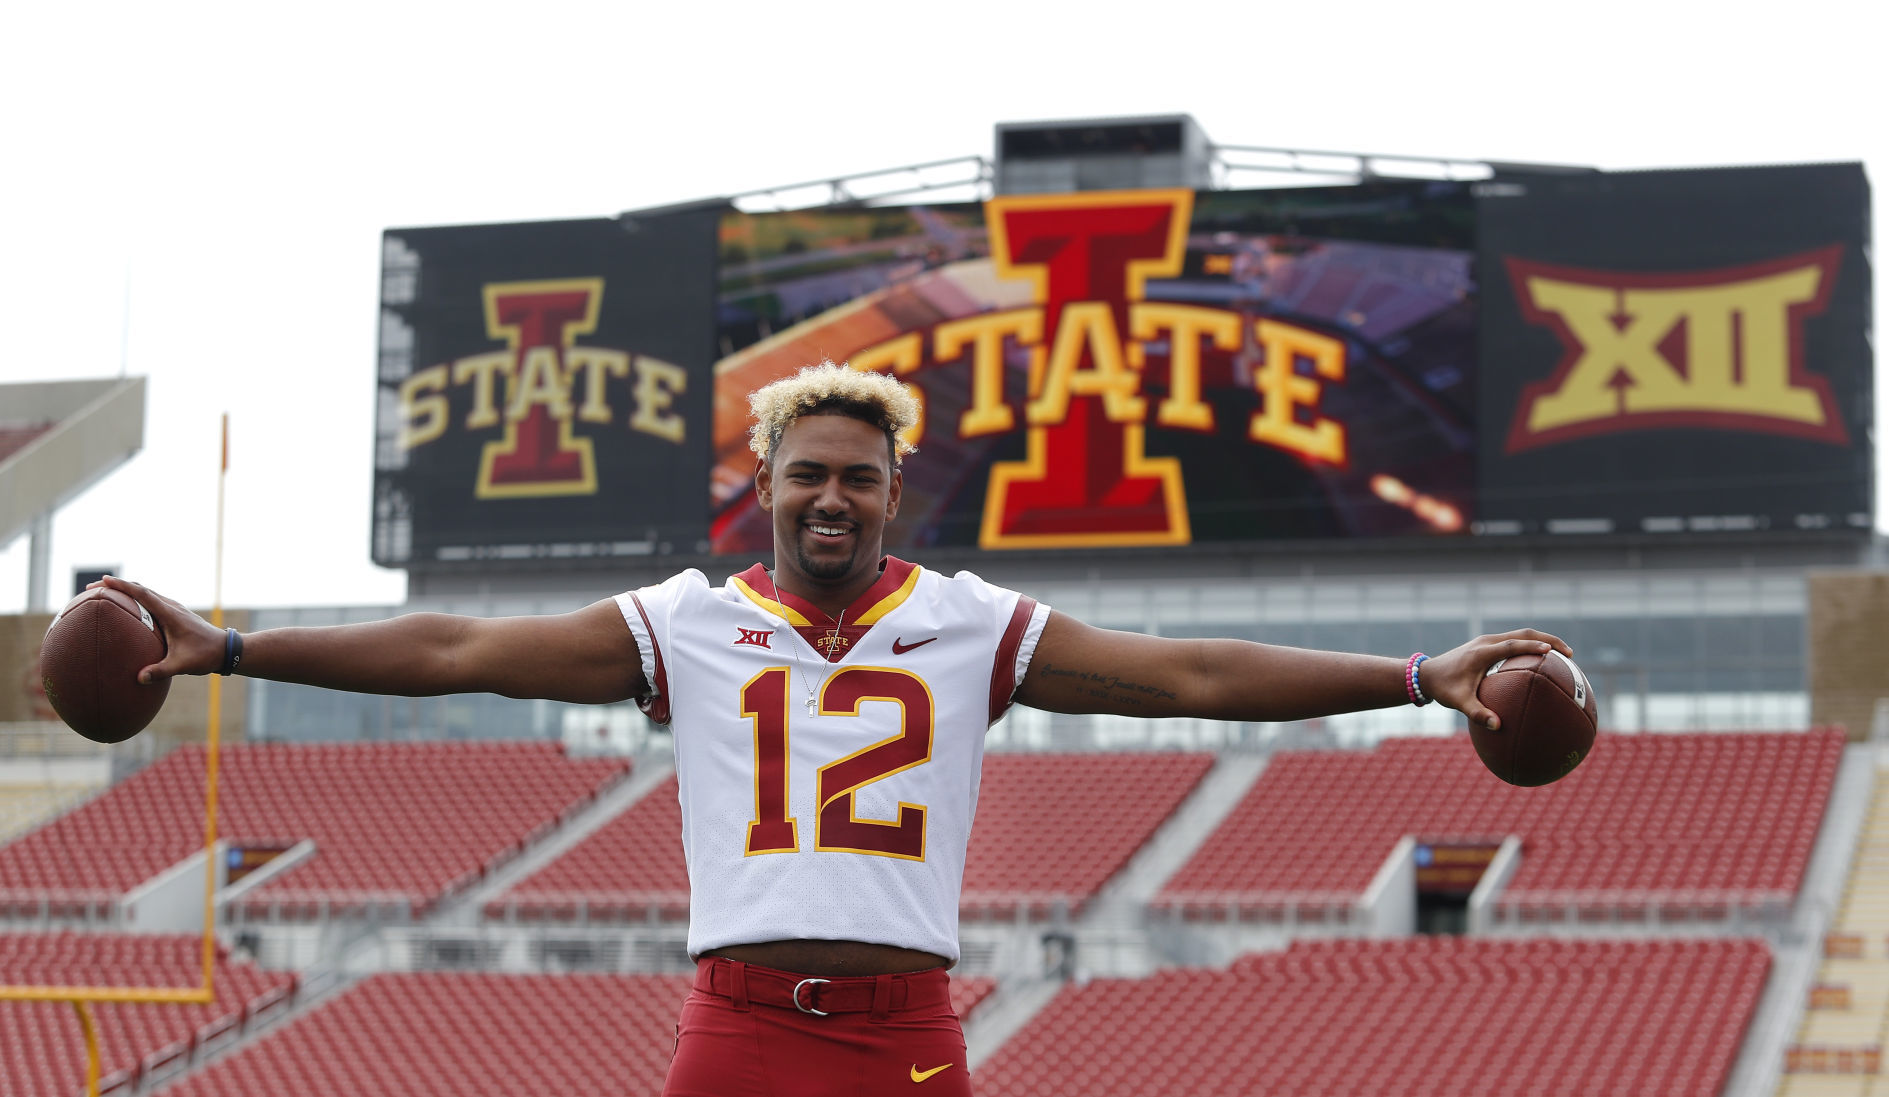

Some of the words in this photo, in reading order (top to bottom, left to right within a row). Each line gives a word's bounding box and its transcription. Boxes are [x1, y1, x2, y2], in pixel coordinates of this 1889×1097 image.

[395, 346, 687, 444] STATE
[1525, 262, 1828, 434] XII
[733, 626, 775, 650] XII
[817, 636, 849, 647] STATE
[740, 665, 935, 863] 12
